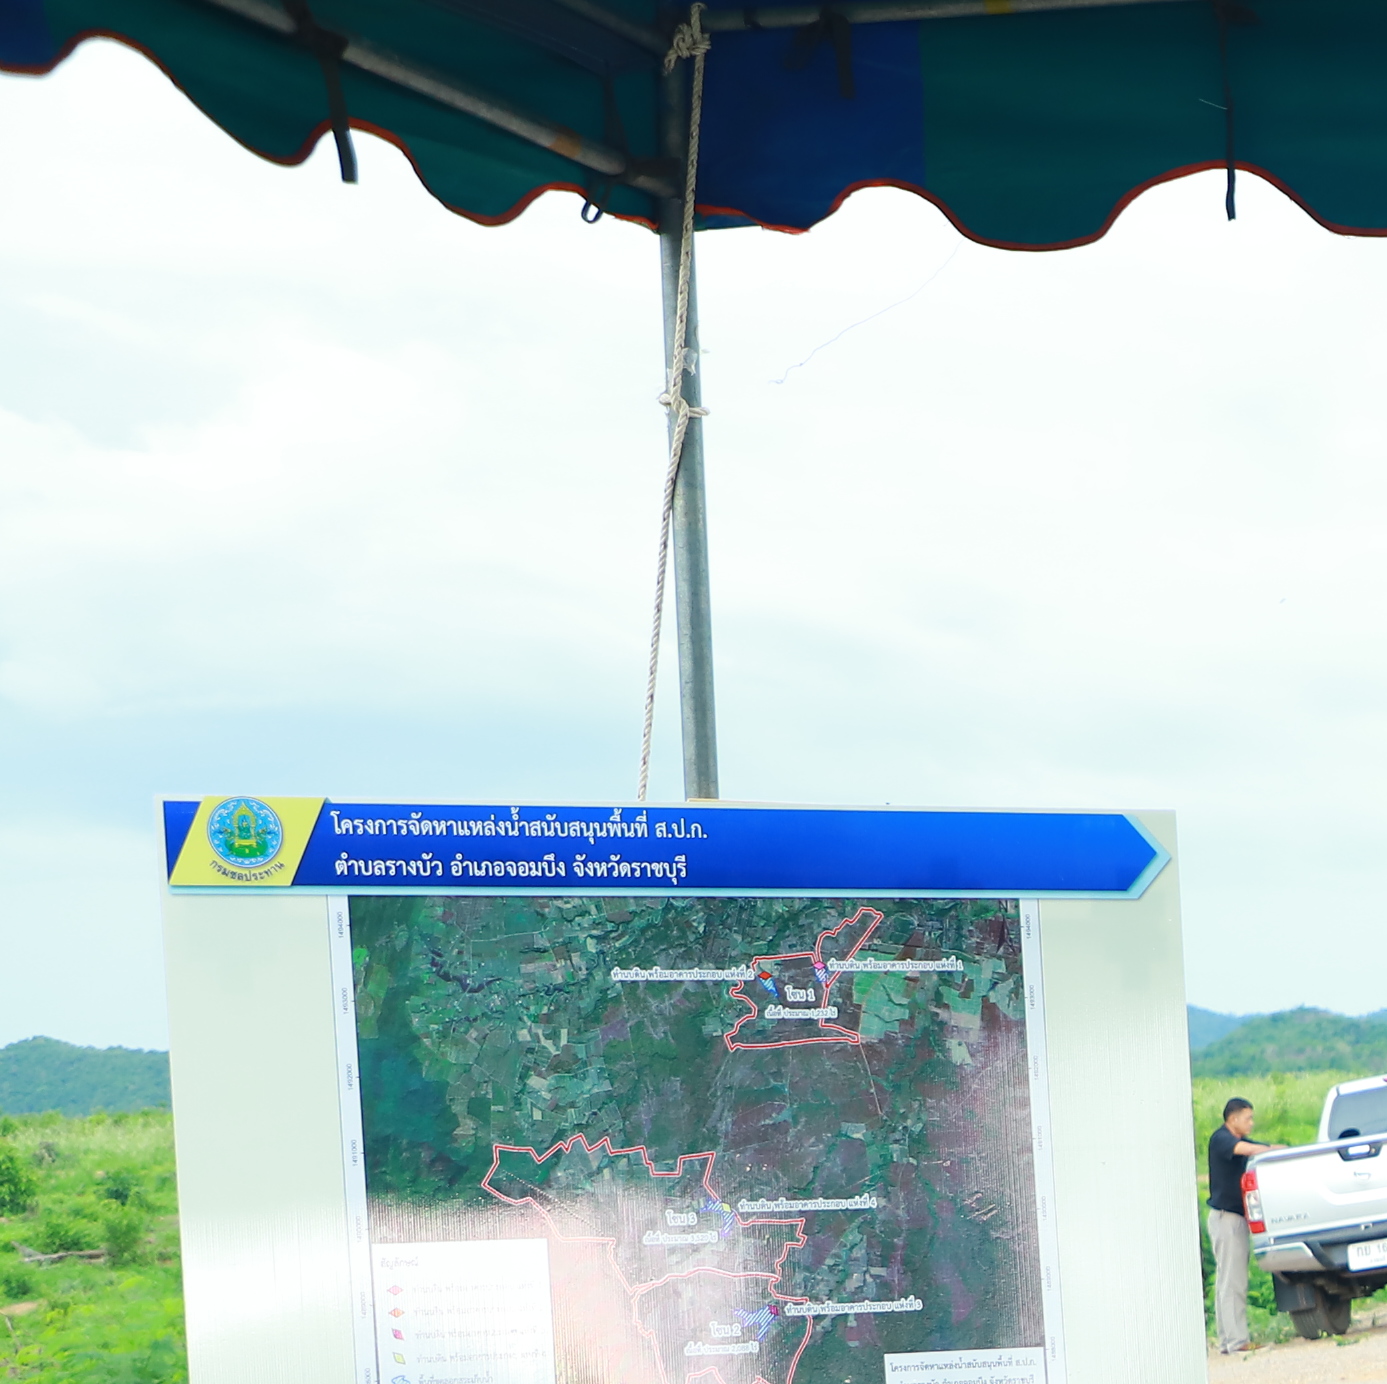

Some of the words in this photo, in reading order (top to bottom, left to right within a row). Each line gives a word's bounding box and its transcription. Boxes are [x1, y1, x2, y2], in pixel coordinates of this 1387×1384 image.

[329, 806, 648, 845] โครงการจัดหาแหล่งน้ำสนับสนุนพื้นที่
[654, 817, 708, 839] ส.ป.ก.
[209, 859, 285, 882] กรมชลประทาน
[334, 852, 443, 876] ตำบลรางบัว
[450, 853, 566, 877] อำเภอจอมบึง
[572, 853, 687, 886] จังหวัดราชบุรี
[958, 960, 963, 971] 1
[745, 970, 753, 980] 2
[786, 987, 804, 999] โซน
[808, 988, 815, 1001] 1
[666, 1210, 687, 1228] โซน
[689, 1212, 697, 1226] 3
[711, 1323, 730, 1336] โซน
[731, 1322, 741, 1337] 2
